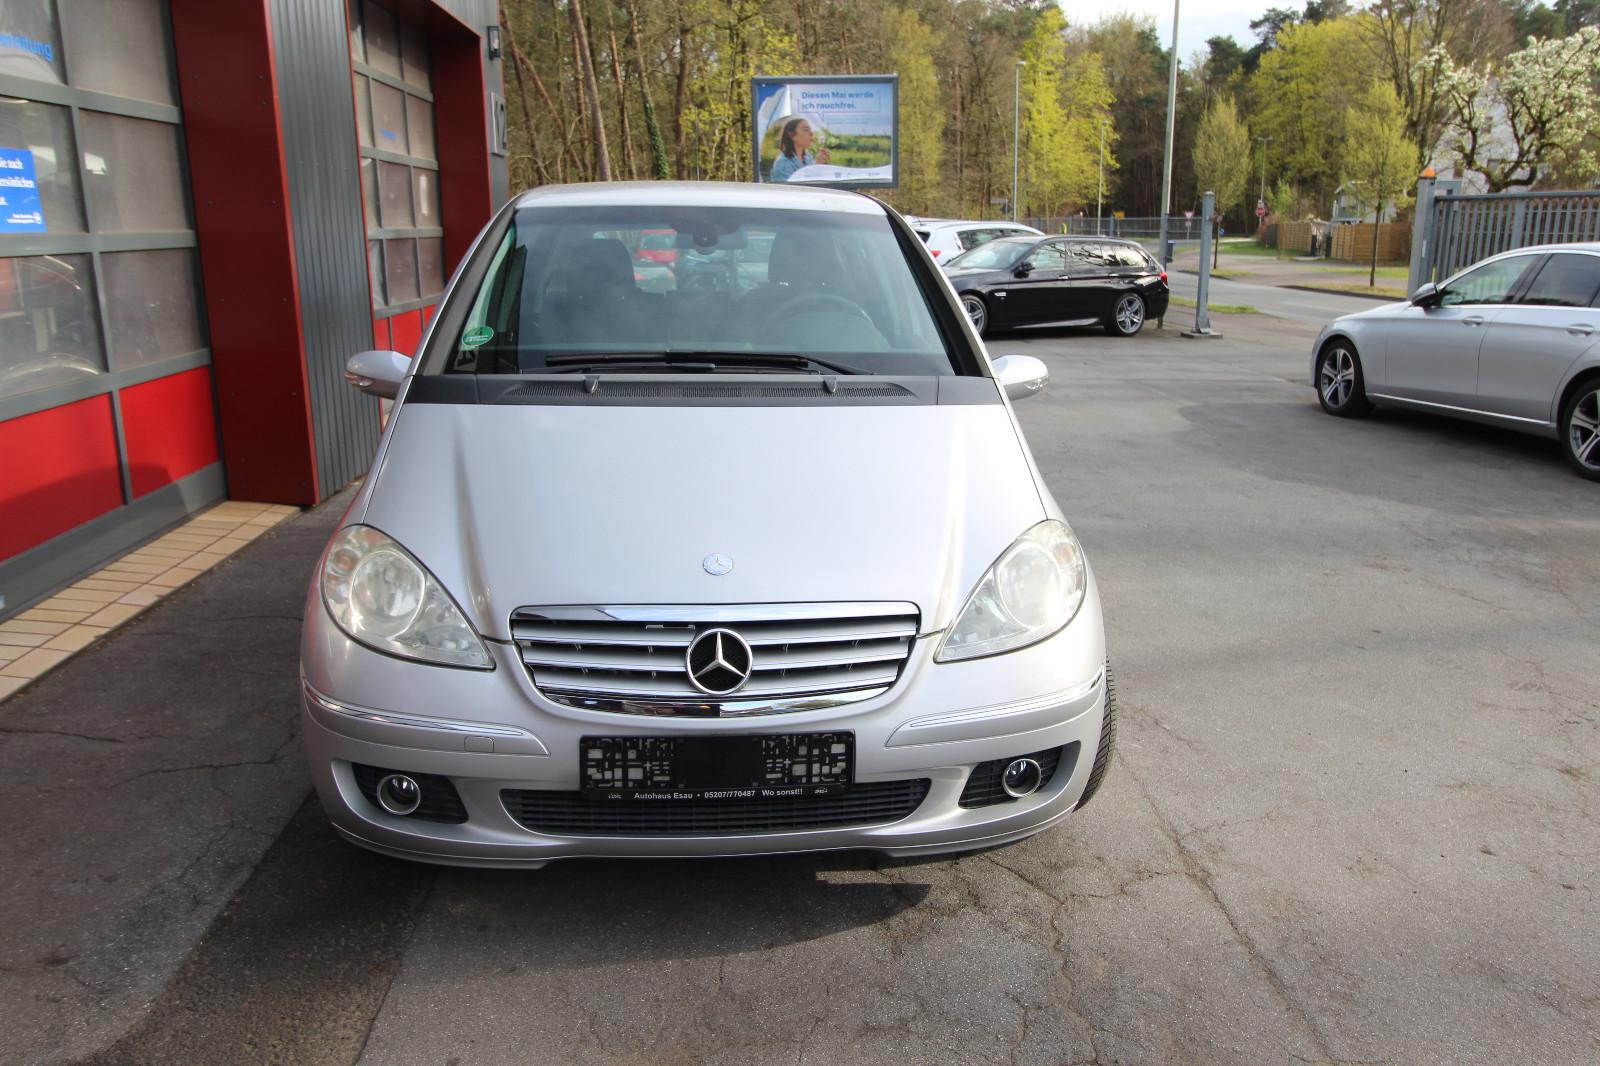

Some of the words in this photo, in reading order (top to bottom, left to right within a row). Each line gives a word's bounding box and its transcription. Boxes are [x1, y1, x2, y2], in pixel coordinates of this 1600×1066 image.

[801, 91, 830, 99] Diesen
[832, 91, 847, 99] Mai
[848, 90, 874, 98] werde
[704, 790, 756, 798] 05207/770487
[776, 788, 803, 796] sonst!!
